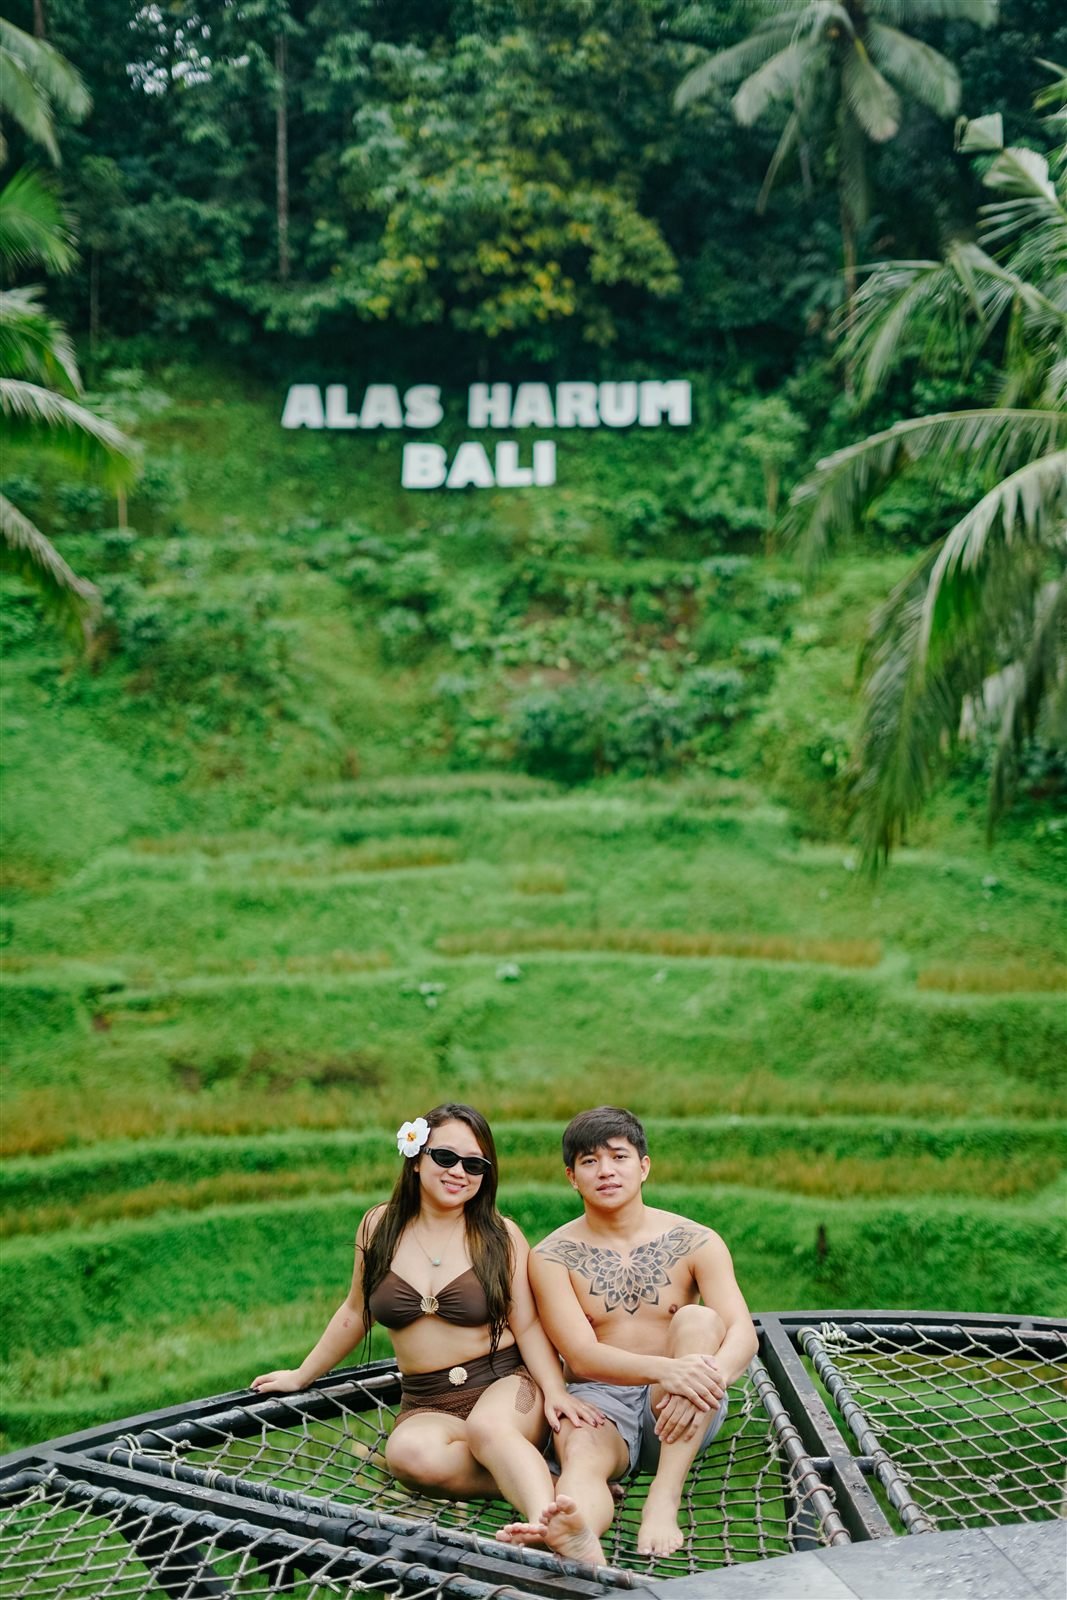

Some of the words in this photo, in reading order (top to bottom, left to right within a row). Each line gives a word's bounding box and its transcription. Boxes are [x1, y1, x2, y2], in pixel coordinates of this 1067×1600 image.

[282, 385, 443, 429] ALAS
[468, 380, 692, 428] HARUM
[401, 440, 556, 489] BALI
